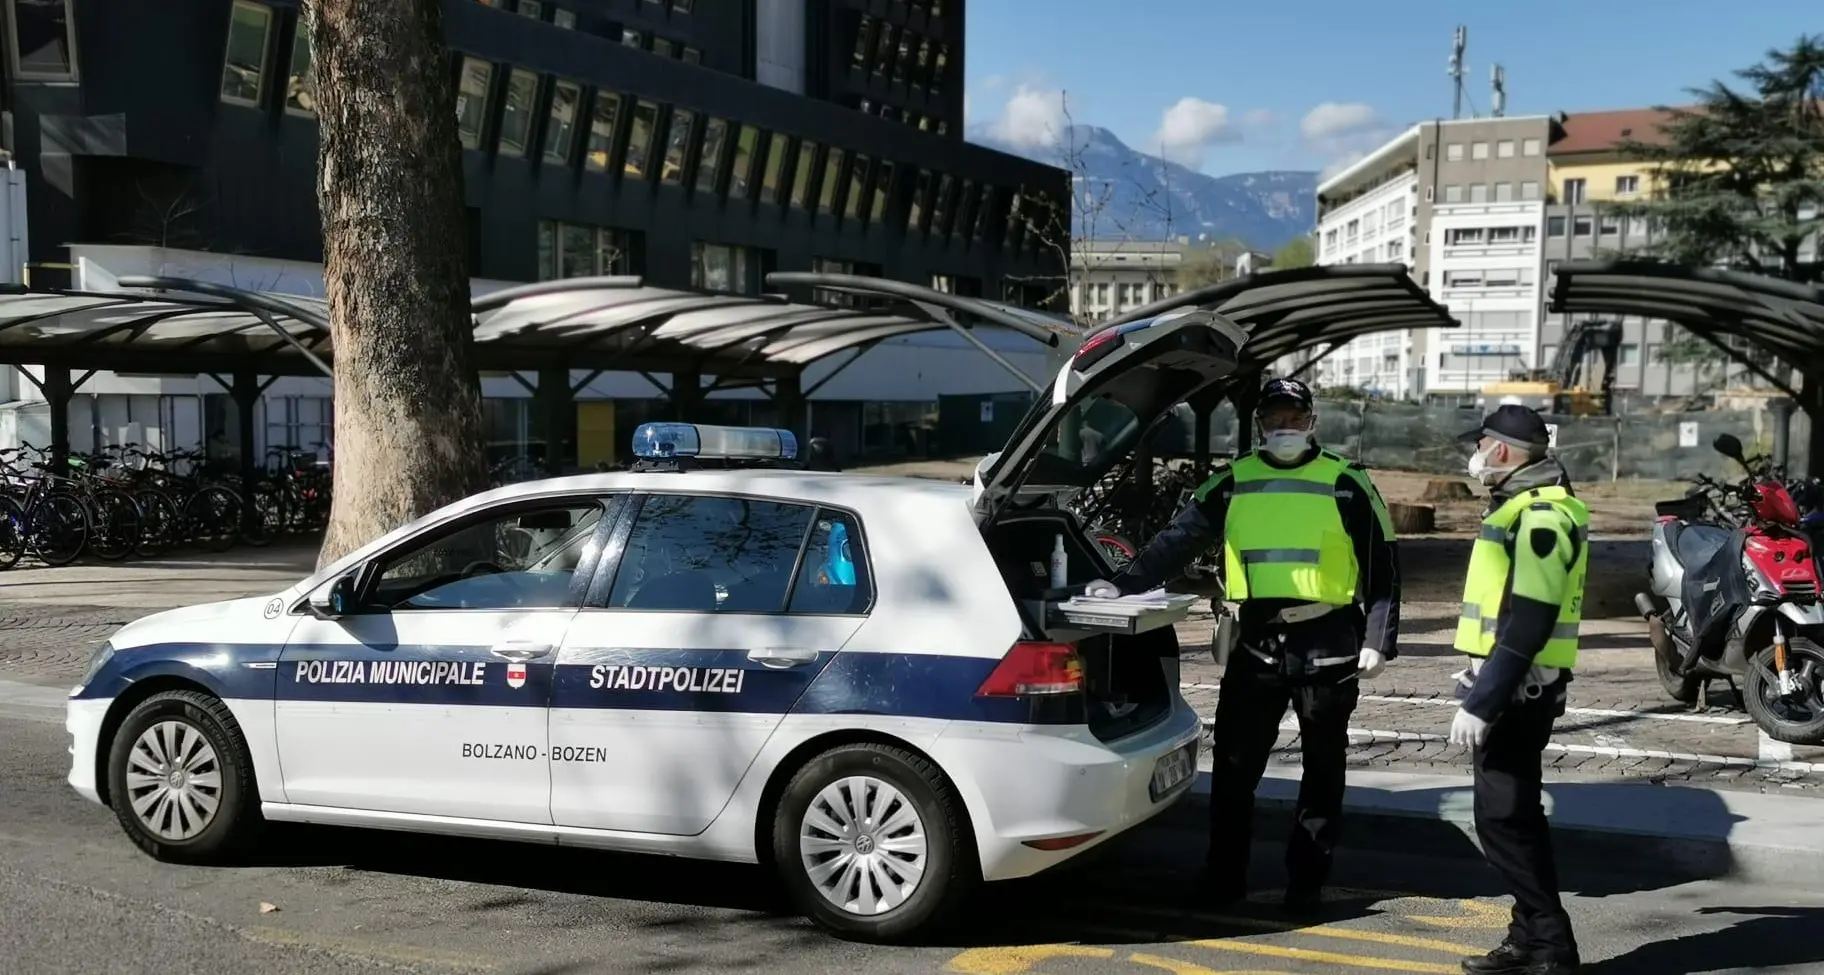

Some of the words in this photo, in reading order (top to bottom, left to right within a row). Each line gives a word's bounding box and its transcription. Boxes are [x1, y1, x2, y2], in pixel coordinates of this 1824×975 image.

[267, 603, 281, 614] 04
[295, 660, 365, 683] POLIZIA
[369, 661, 487, 685] MUNICIPALE
[589, 665, 745, 693] STADTPOLIZEI
[462, 743, 537, 760] BOLZANO
[552, 746, 607, 762] BOZEN
